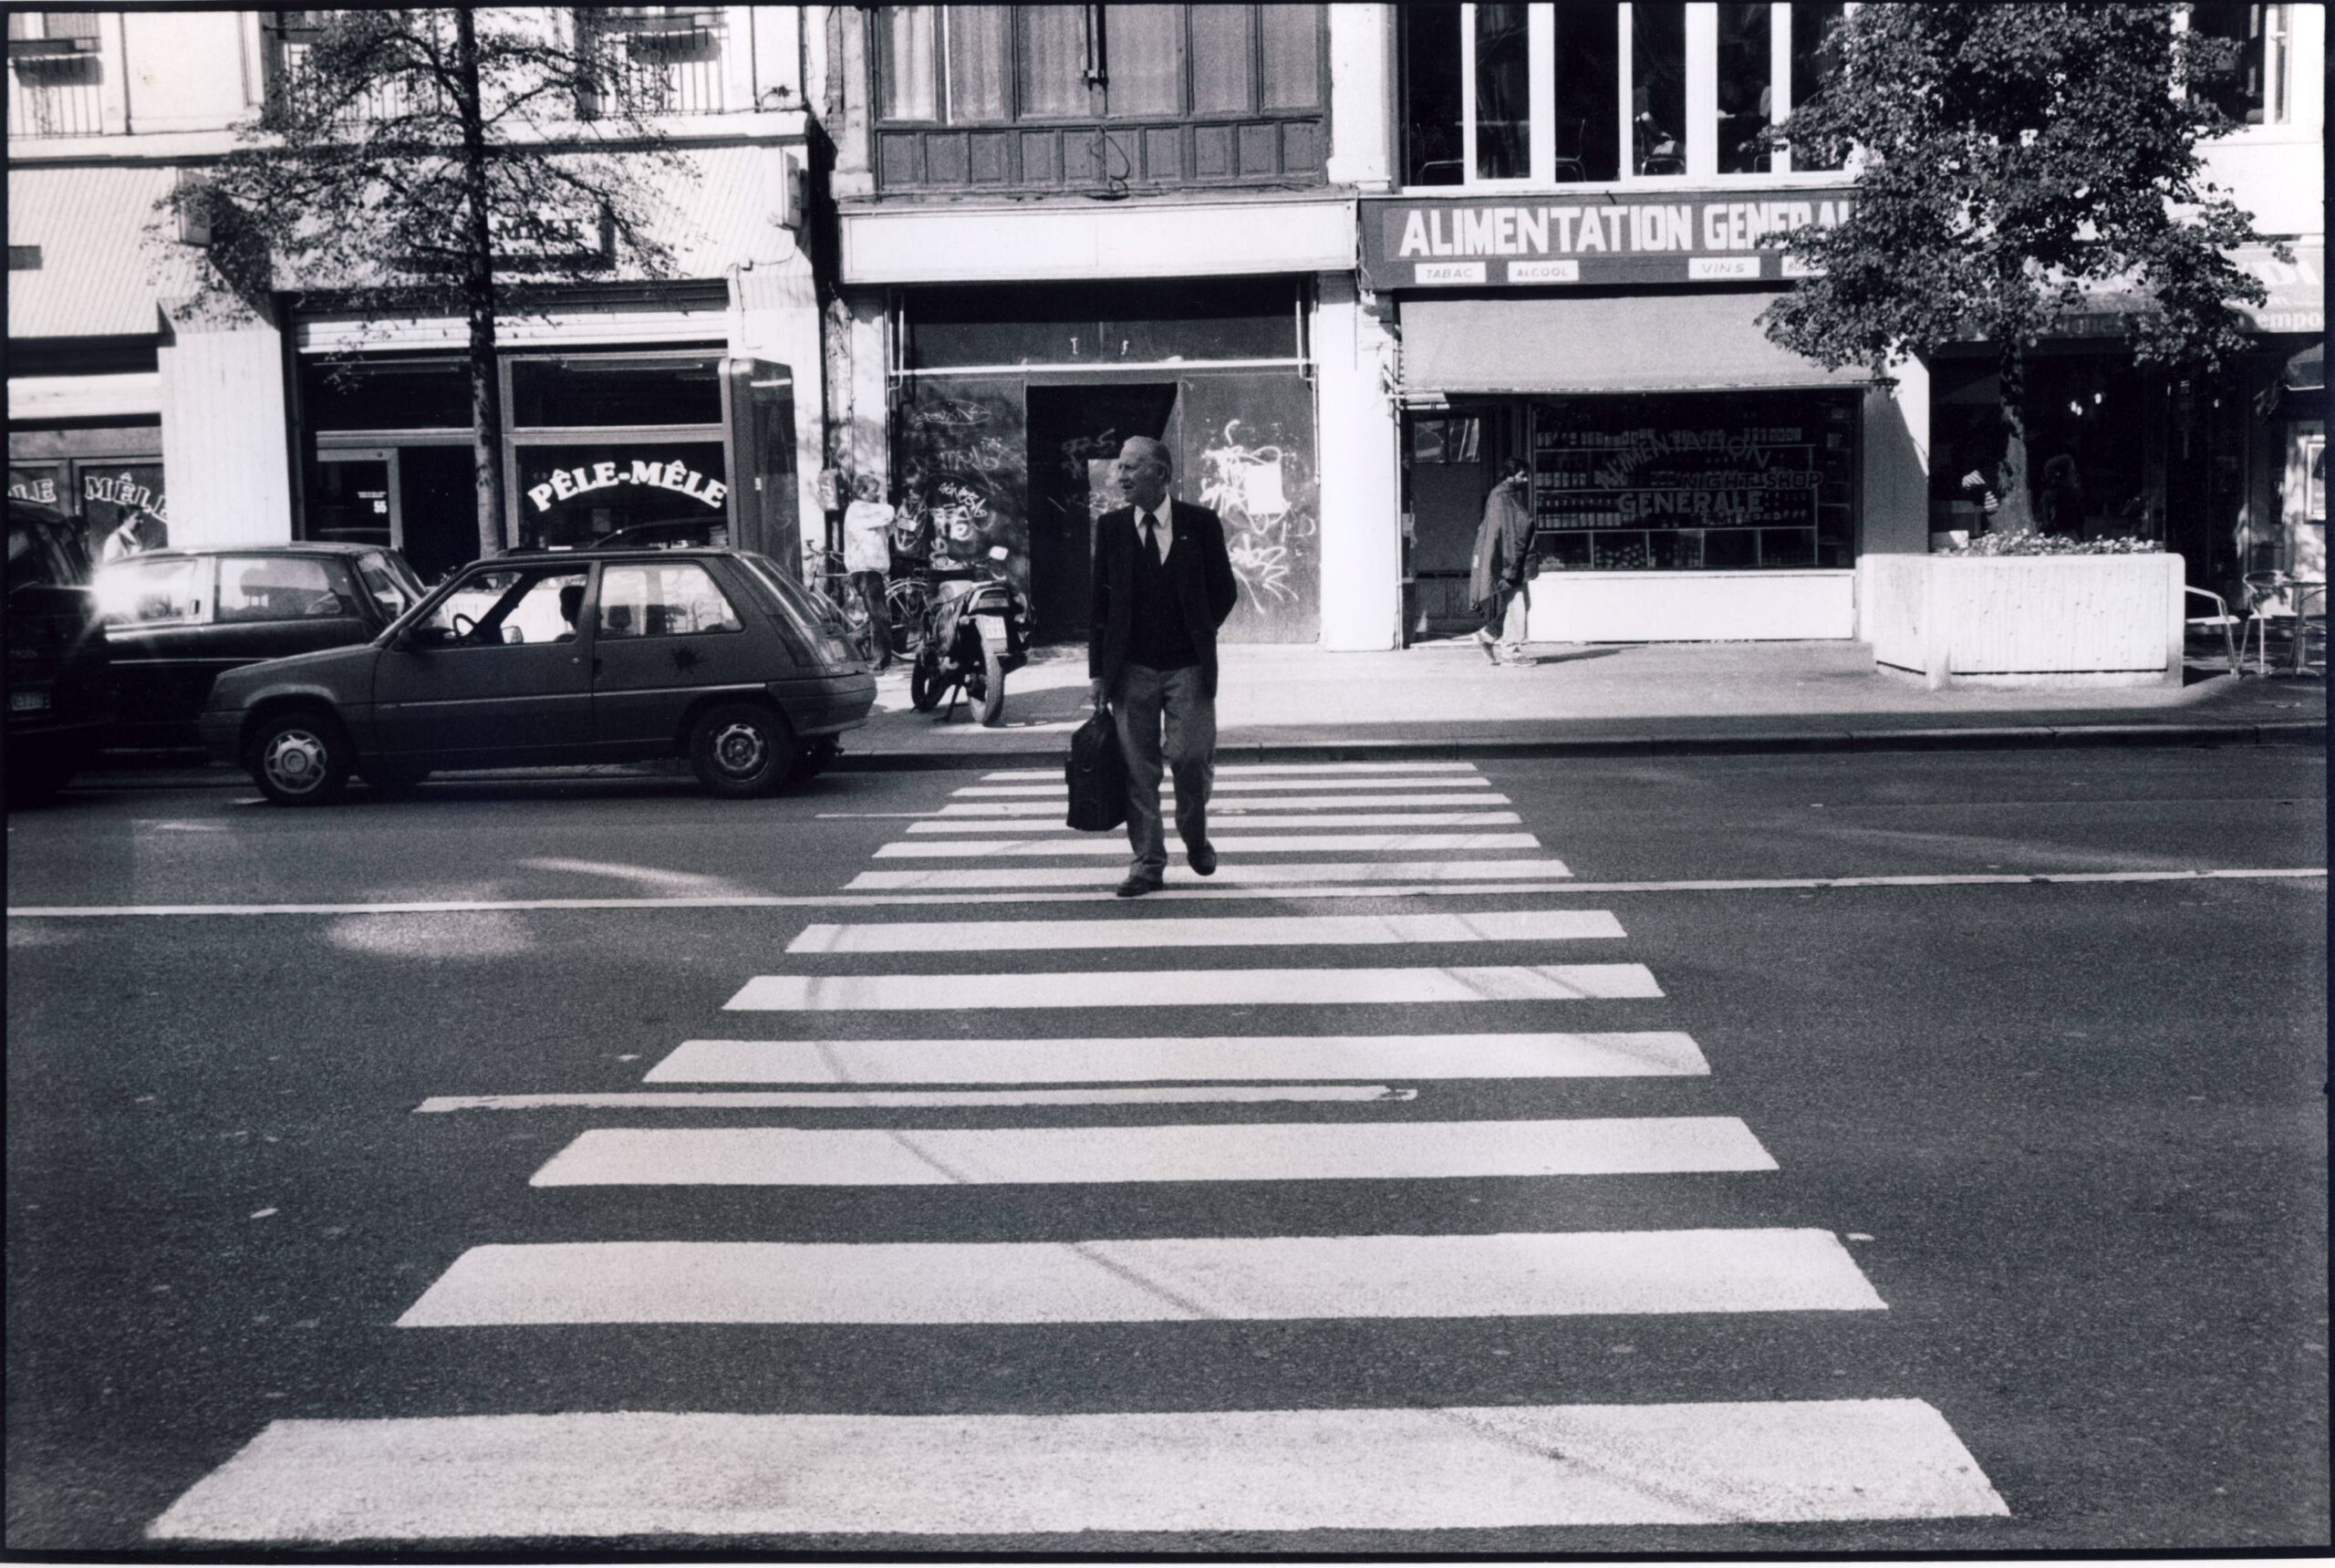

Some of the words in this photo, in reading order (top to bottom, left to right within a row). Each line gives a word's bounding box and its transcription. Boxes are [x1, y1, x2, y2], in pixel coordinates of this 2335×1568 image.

[1397, 205, 1693, 257] ALIMENTATION
[1703, 201, 1863, 250] GENERA
[1426, 268, 1474, 280] TABAC
[1516, 266, 1569, 278] ALCOOL
[1701, 263, 1746, 275] VINS
[527, 459, 728, 513] PÊLE-MÊLE
